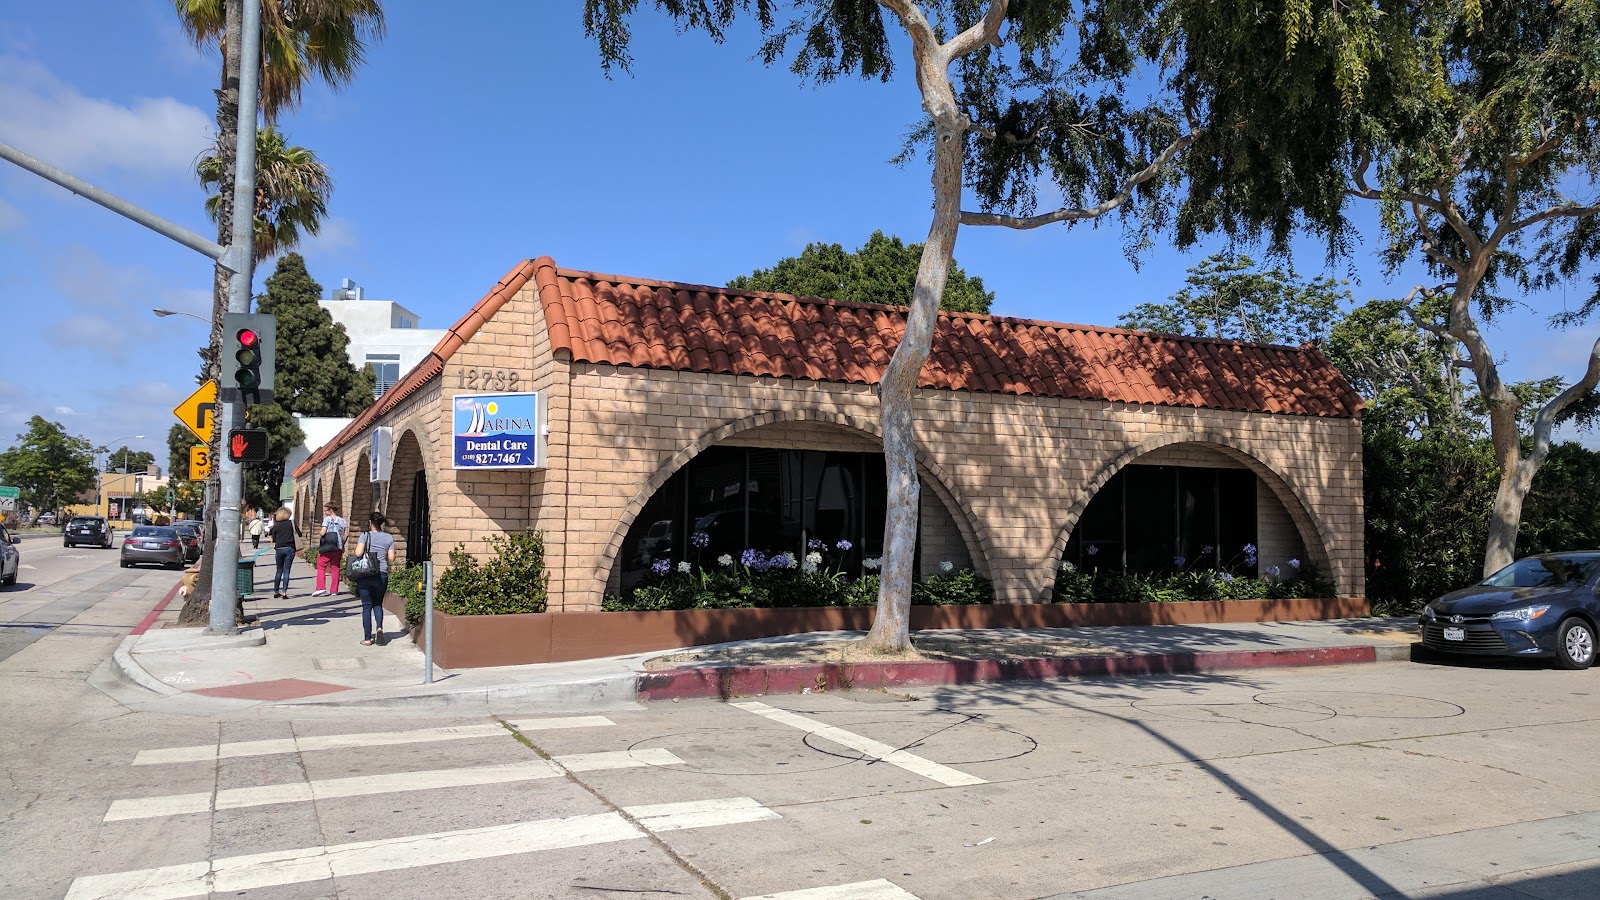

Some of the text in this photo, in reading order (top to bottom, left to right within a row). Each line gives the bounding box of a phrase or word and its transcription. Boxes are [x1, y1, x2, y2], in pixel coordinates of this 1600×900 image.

[457, 367, 520, 391] 12732
[466, 439, 528, 451] Dental Care
[475, 452, 521, 464] 827-7467
